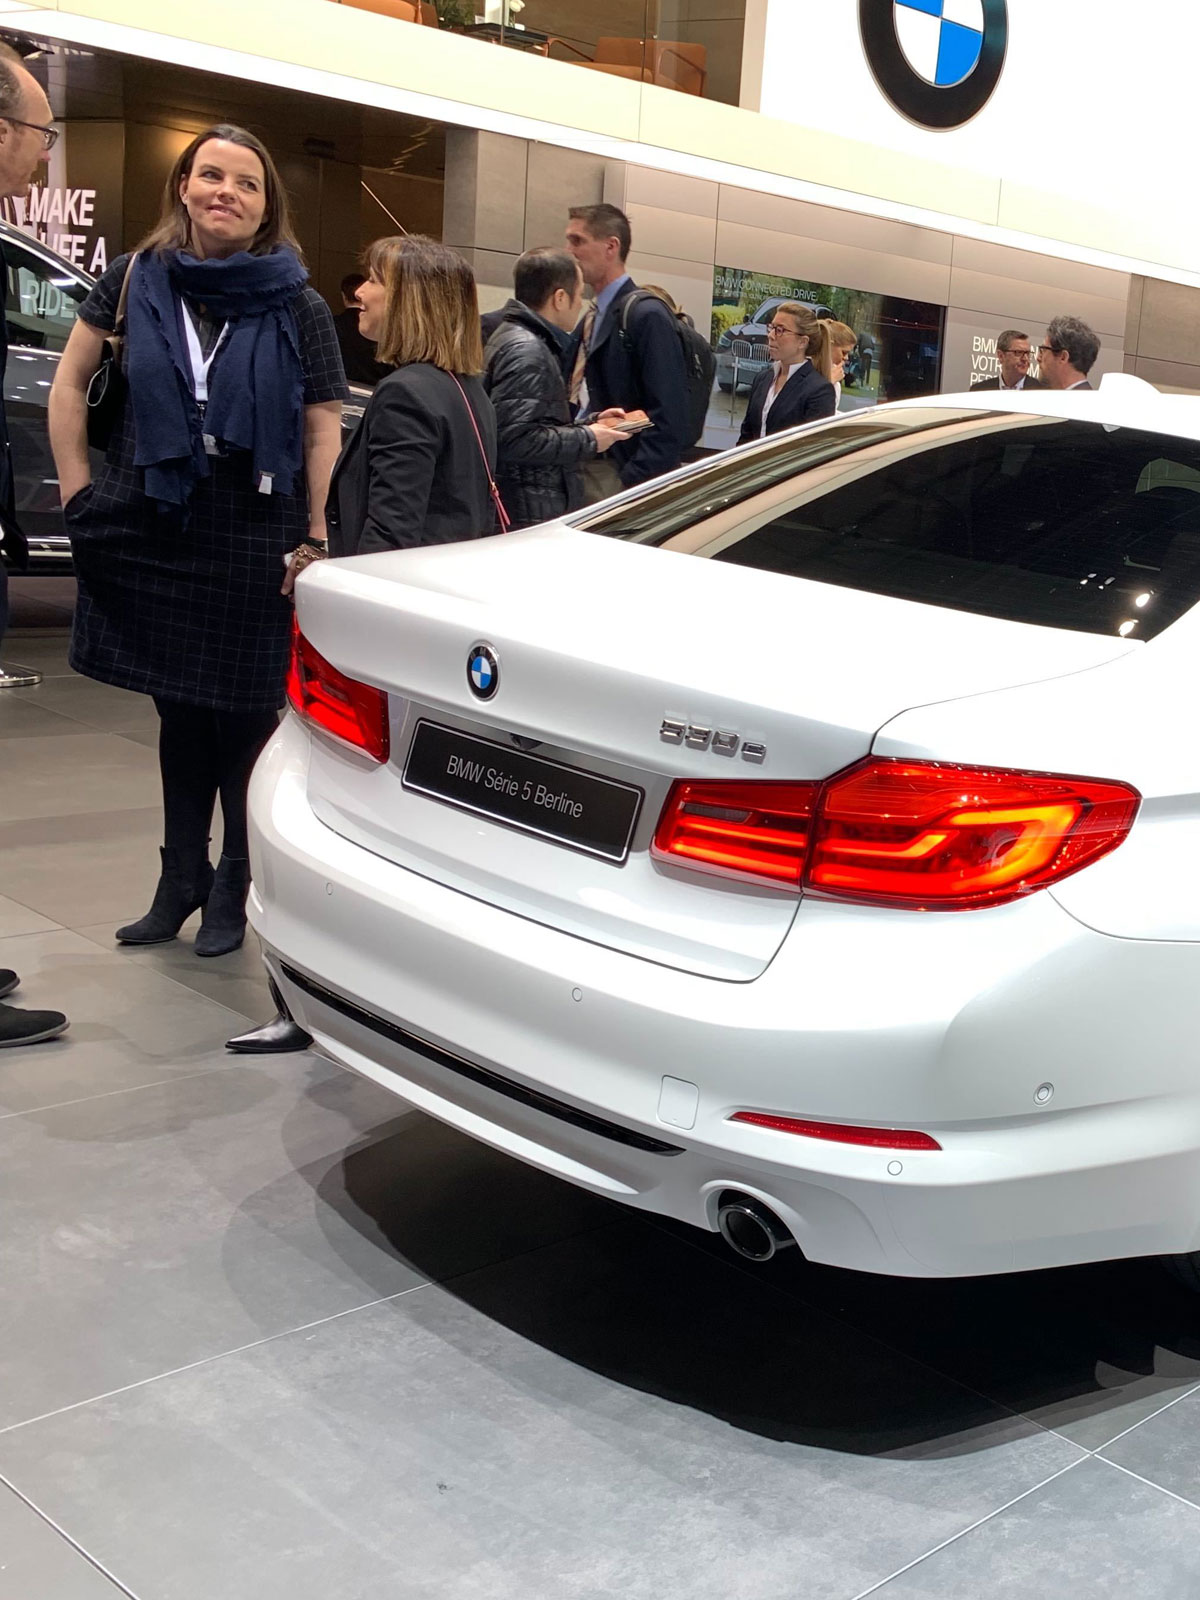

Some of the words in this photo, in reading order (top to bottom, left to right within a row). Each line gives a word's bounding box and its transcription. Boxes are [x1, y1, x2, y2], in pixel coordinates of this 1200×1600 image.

[29, 186, 97, 226] MAKE
[89, 236, 107, 273] A
[715, 275, 739, 289] BMW
[739, 279, 792, 298] CONNECTED
[793, 288, 817, 301] DRIVE
[971, 354, 1003, 373] VOTR
[446, 755, 485, 784] BMW
[484, 768, 519, 797] Série
[521, 780, 533, 801] 5
[533, 784, 583, 818] Berline
